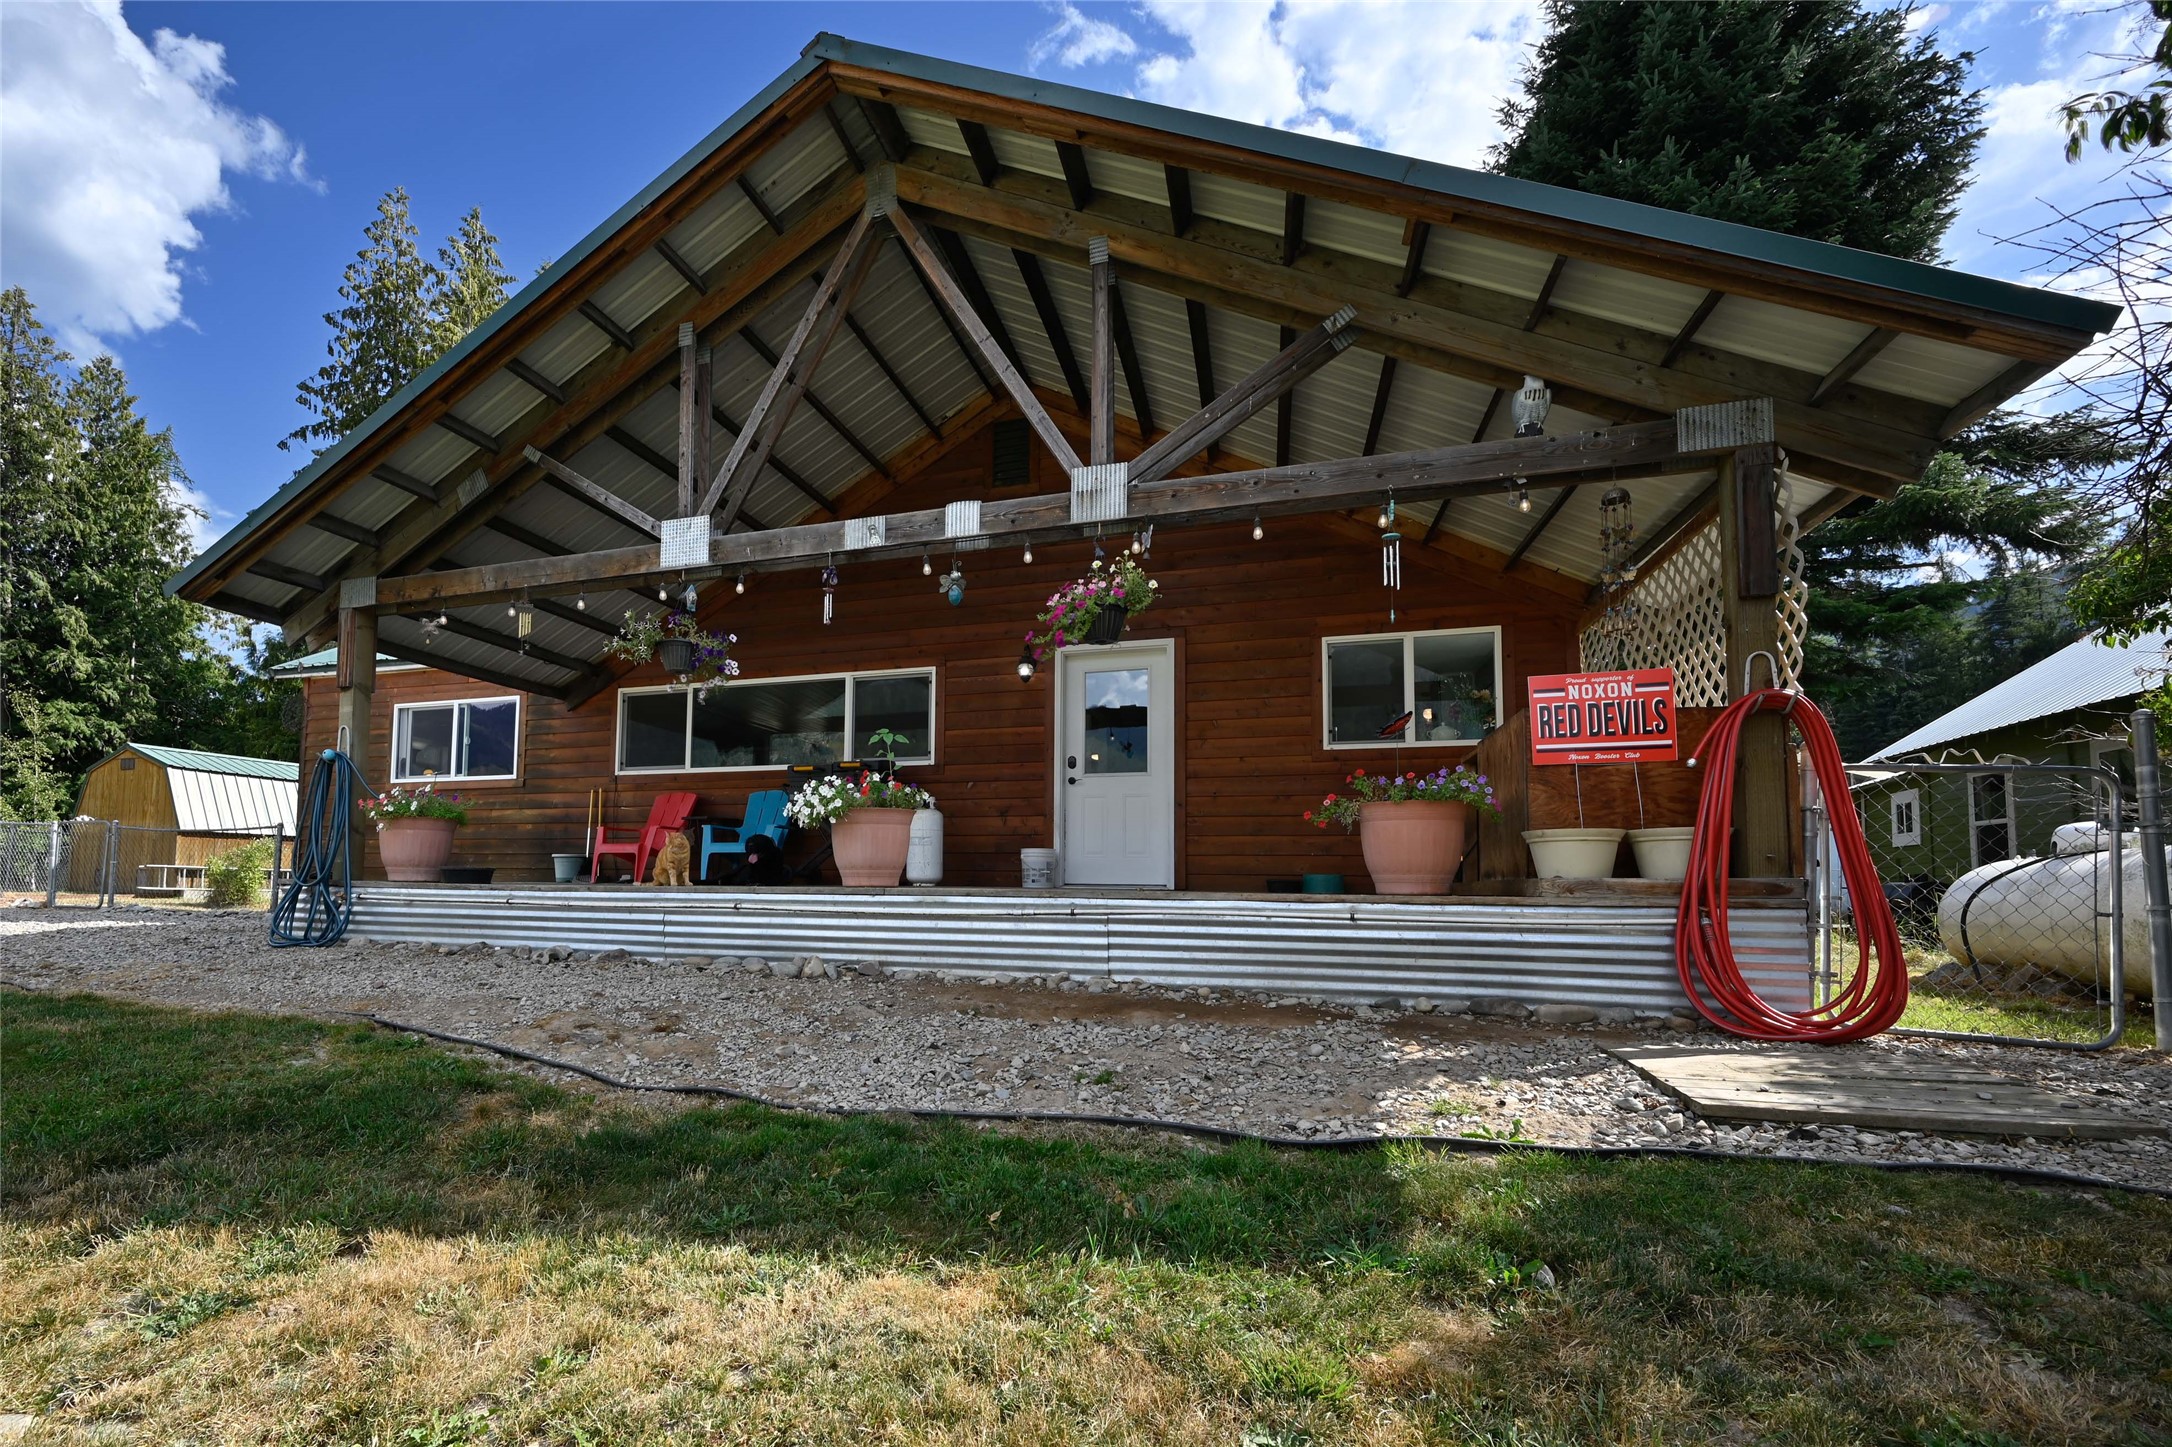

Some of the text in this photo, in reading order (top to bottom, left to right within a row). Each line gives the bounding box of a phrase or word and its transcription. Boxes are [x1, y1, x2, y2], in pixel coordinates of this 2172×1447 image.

[1591, 675, 1622, 683] supporter
[1568, 682, 1633, 700] NOXON
[1537, 697, 1668, 739] RED DEVILS
[1594, 752, 1620, 760] Booster
[1624, 751, 1640, 759] Club
